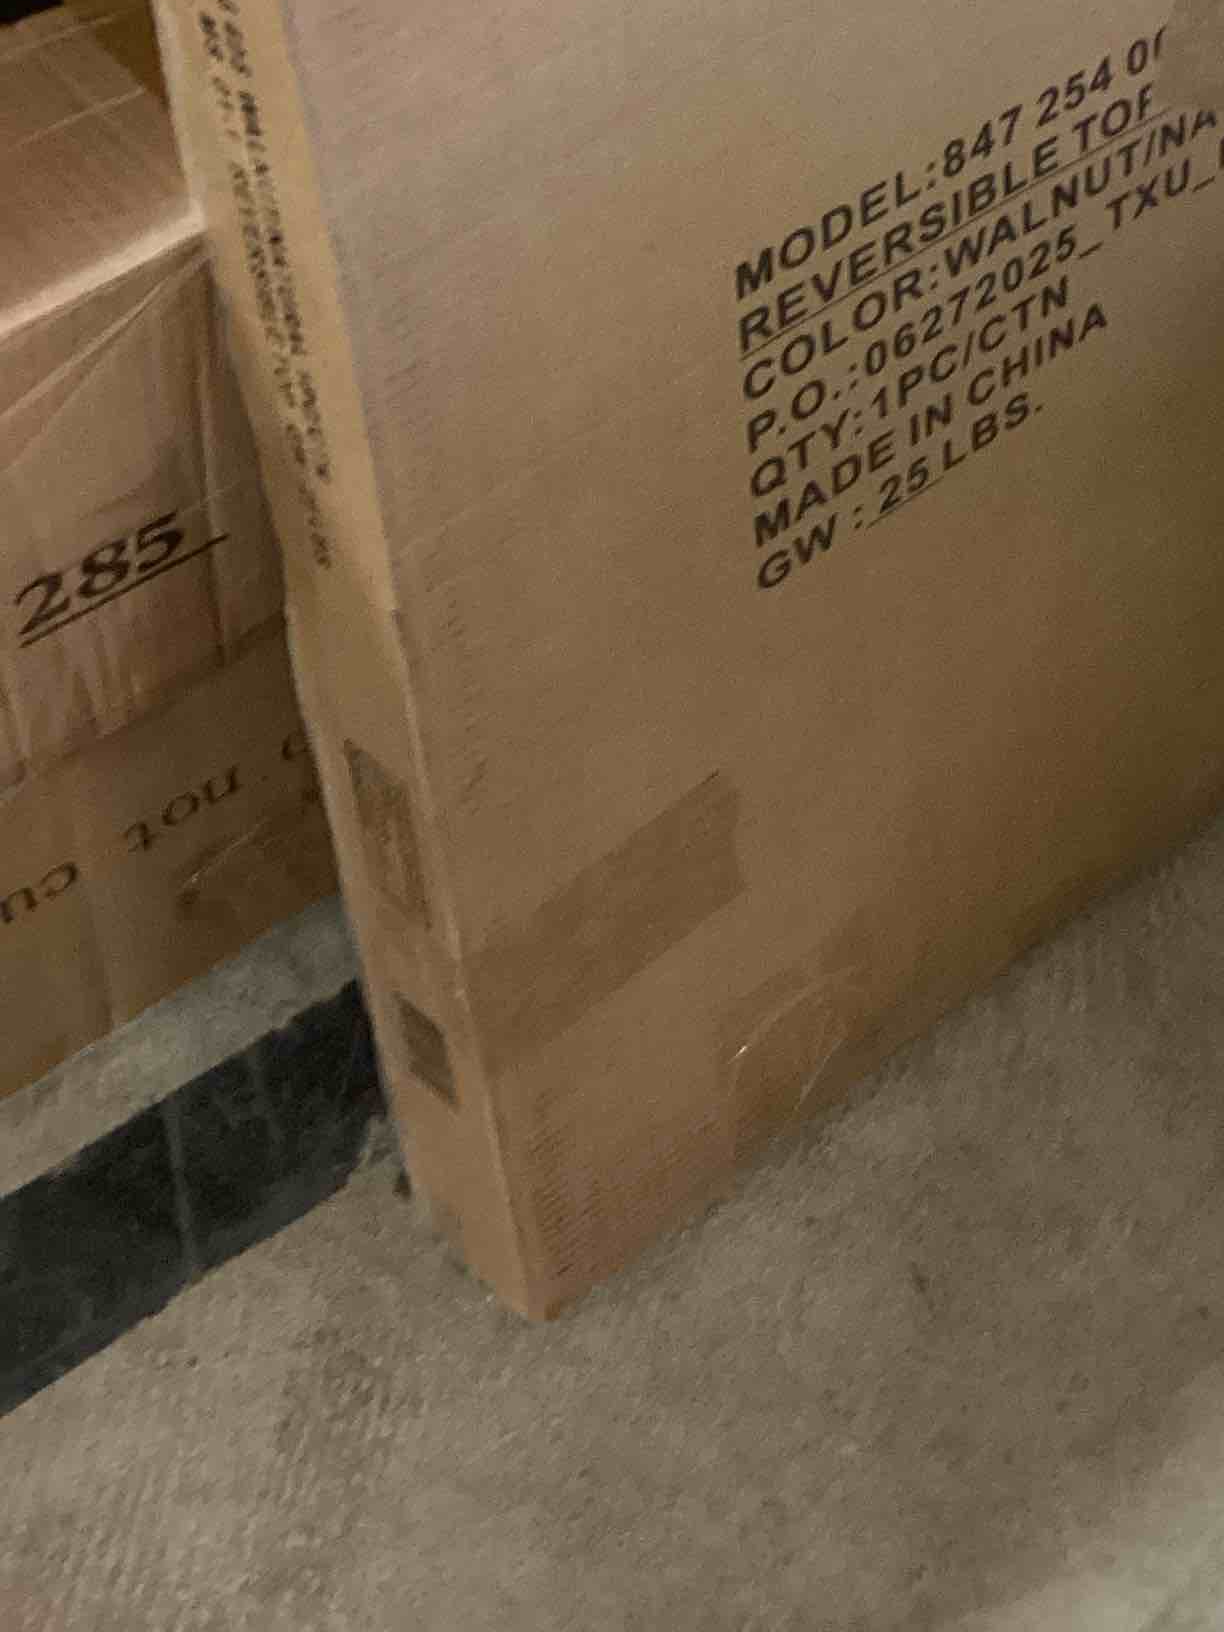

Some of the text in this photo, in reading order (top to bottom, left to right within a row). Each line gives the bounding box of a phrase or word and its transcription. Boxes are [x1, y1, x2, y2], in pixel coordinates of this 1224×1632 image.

[735, 104, 1022, 301] MODEL:847
[1035, 55, 1115, 129] 254
[741, 135, 1059, 353] REVERSIBLE
[751, 274, 1068, 498] QTY:1PC/CTN
[755, 303, 1108, 548] MADE IN CHINA
[878, 456, 930, 514] 25
[943, 392, 1044, 471] LBS.
[15, 510, 185, 636] 285
[123, 765, 240, 853] not
